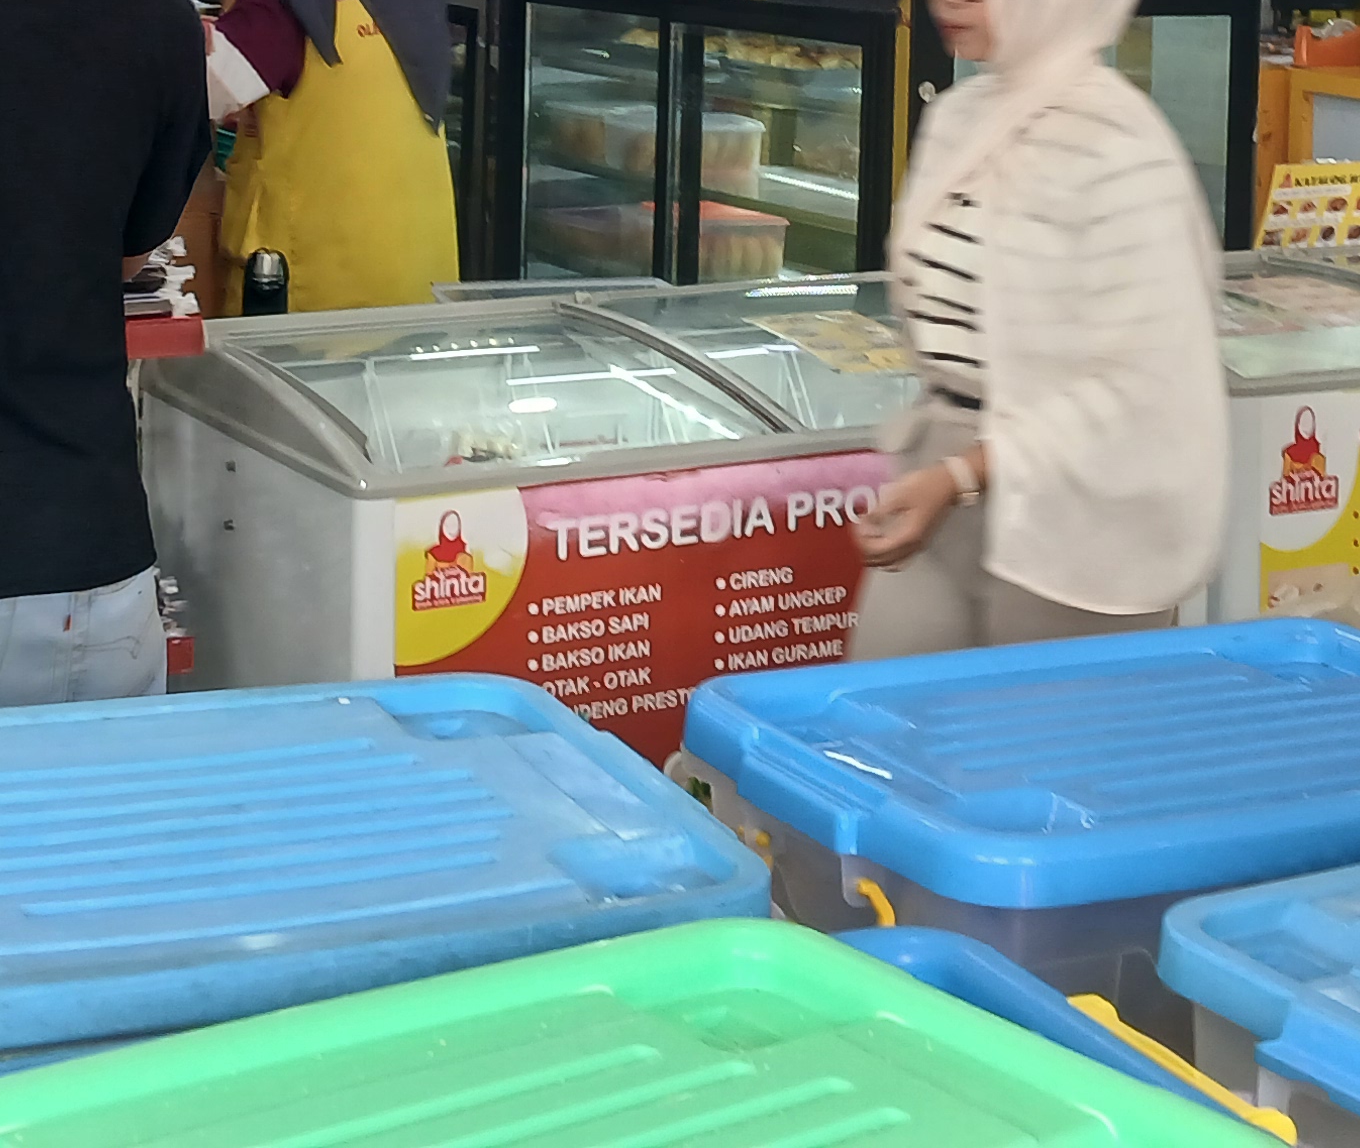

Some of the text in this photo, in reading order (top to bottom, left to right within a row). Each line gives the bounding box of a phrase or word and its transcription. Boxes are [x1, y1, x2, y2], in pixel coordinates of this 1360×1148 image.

[1271, 471, 1337, 505] shinta
[550, 499, 776, 562] TERSEDIA
[414, 570, 485, 602] shinta
[729, 566, 794, 591] CIRENG
[542, 582, 663, 618] PEMPEK IKAN
[728, 586, 847, 618] AYAM UNGKEP
[541, 612, 650, 645] BAKSO SAPI
[728, 619, 789, 645] UDANG
[541, 640, 651, 673] BAKSO IKAN
[727, 639, 844, 671] IKAN GURAME
[603, 667, 652, 690] OTAK
